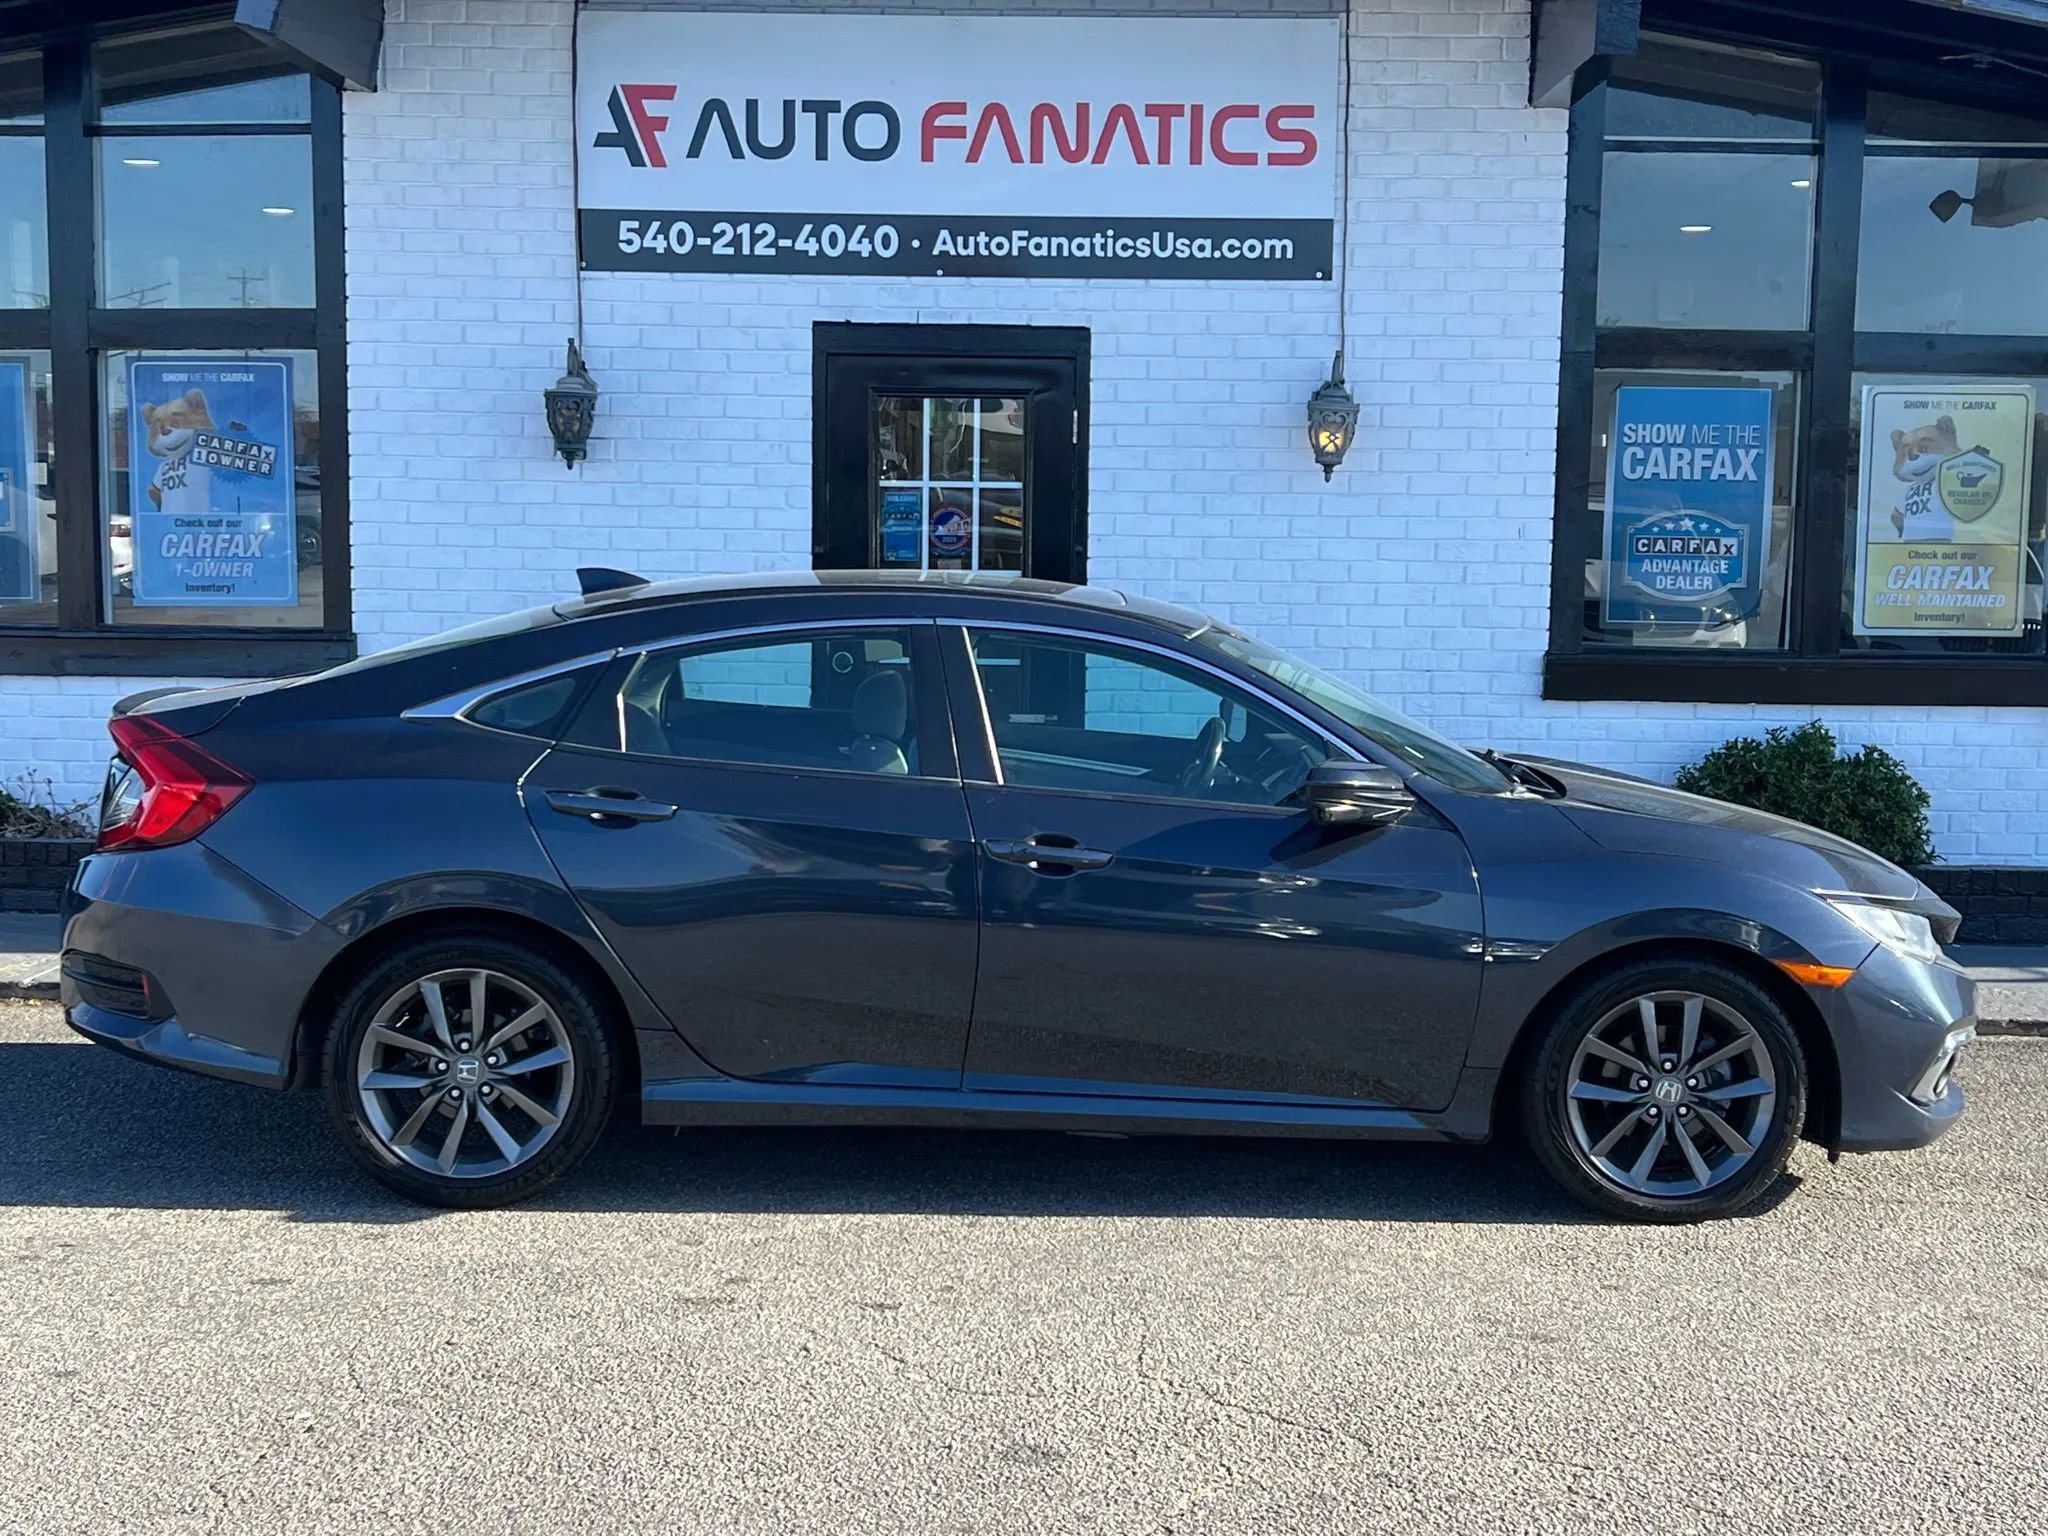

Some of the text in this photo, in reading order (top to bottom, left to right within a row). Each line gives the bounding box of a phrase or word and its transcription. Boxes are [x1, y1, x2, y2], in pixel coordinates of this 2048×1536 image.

[686, 98, 901, 163] AUTO
[920, 101, 1318, 167] FANATICS
[618, 219, 1293, 260] 540-212-4040 AutoFanaticsUsa.com
[162, 372, 189, 383] SHOW
[220, 373, 256, 383] CARFAX
[1903, 399, 1929, 409] SHOW
[1962, 401, 1997, 410] CARFAX
[1623, 423, 1760, 446] SHOW ME THE
[197, 434, 273, 461] CARFAX
[161, 456, 187, 476] CAR
[1622, 446, 1760, 481] CARFAX
[161, 471, 188, 492] FOX
[1905, 482, 1932, 500] CAR
[1905, 498, 1932, 517] FOX
[175, 518, 242, 528] Check out our
[161, 532, 266, 558] CARFAX
[1637, 538, 1735, 555] CARFAX
[1908, 550, 1977, 560] Check out our
[175, 561, 254, 578] 1-OWNER
[1641, 558, 1729, 574] ADVANTAGE
[1656, 575, 1713, 590] DEALER
[1887, 564, 1995, 590] CARFAX
[185, 582, 236, 594] Inventory!
[1875, 592, 2006, 607] WELL MAINTAINED
[1914, 612, 1965, 624] Inventory!
